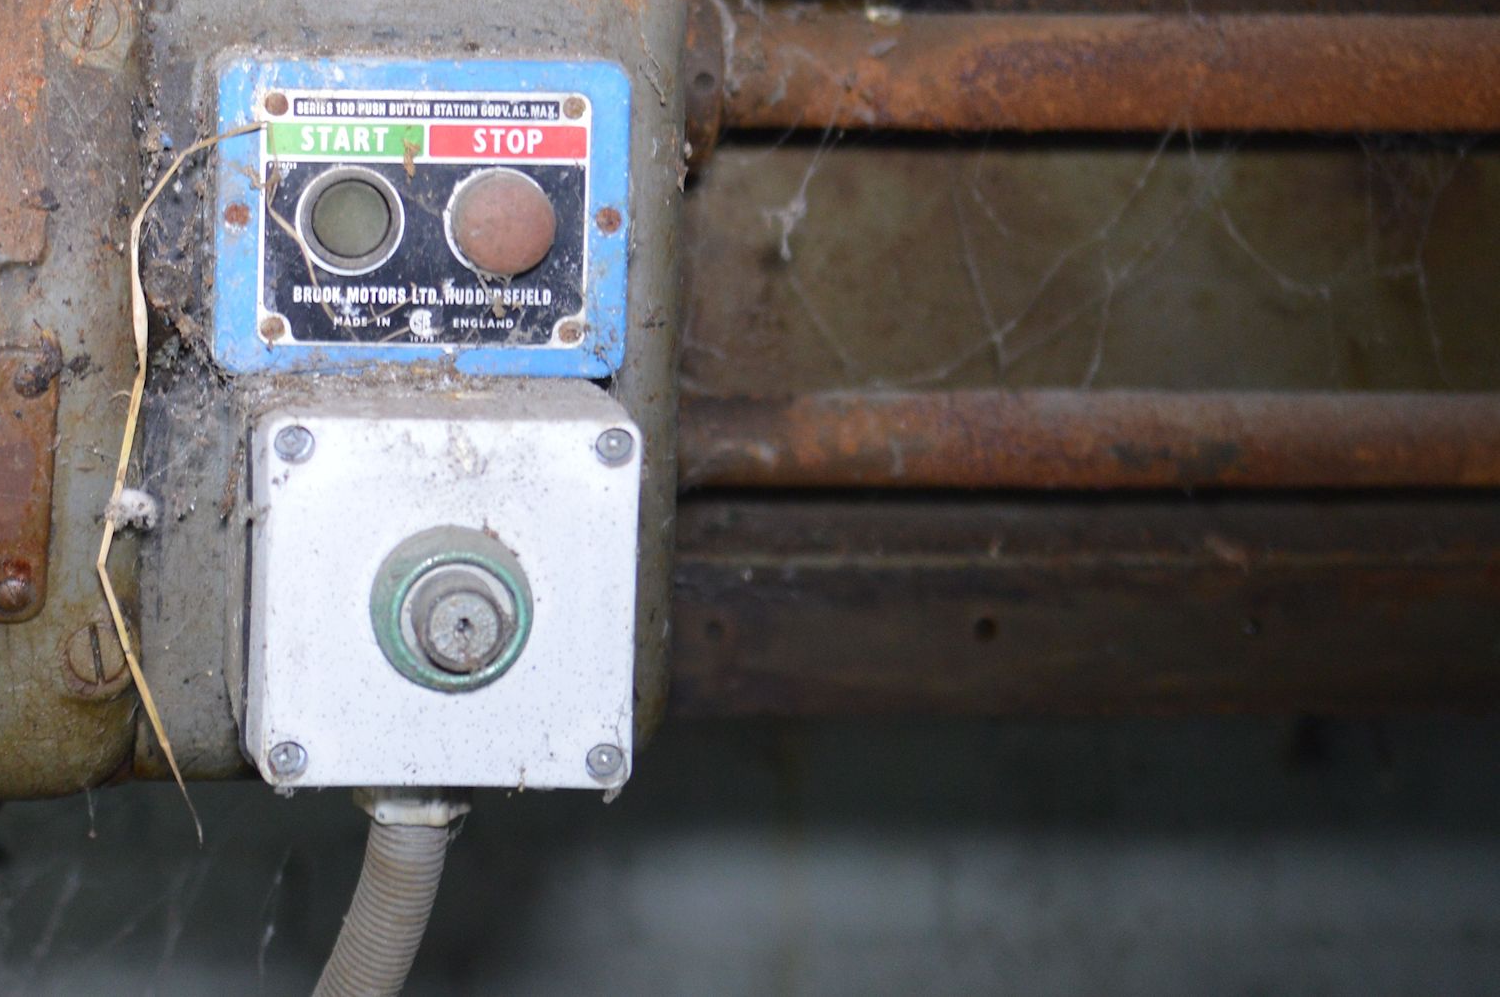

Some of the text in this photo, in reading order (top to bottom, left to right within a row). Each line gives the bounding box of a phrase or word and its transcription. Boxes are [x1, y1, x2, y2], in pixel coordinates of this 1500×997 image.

[296, 101, 334, 115] SERIES
[336, 101, 356, 115] 100
[358, 101, 387, 116] PUSH
[389, 102, 431, 117] BUTTON
[433, 103, 478, 117] STATION
[300, 126, 389, 153] START
[473, 129, 543, 155] STOP
[292, 285, 341, 303] BROOK
[346, 286, 407, 304] MOTORS
[333, 316, 391, 328] MADE IN
[452, 317, 515, 329] ENGLAND
